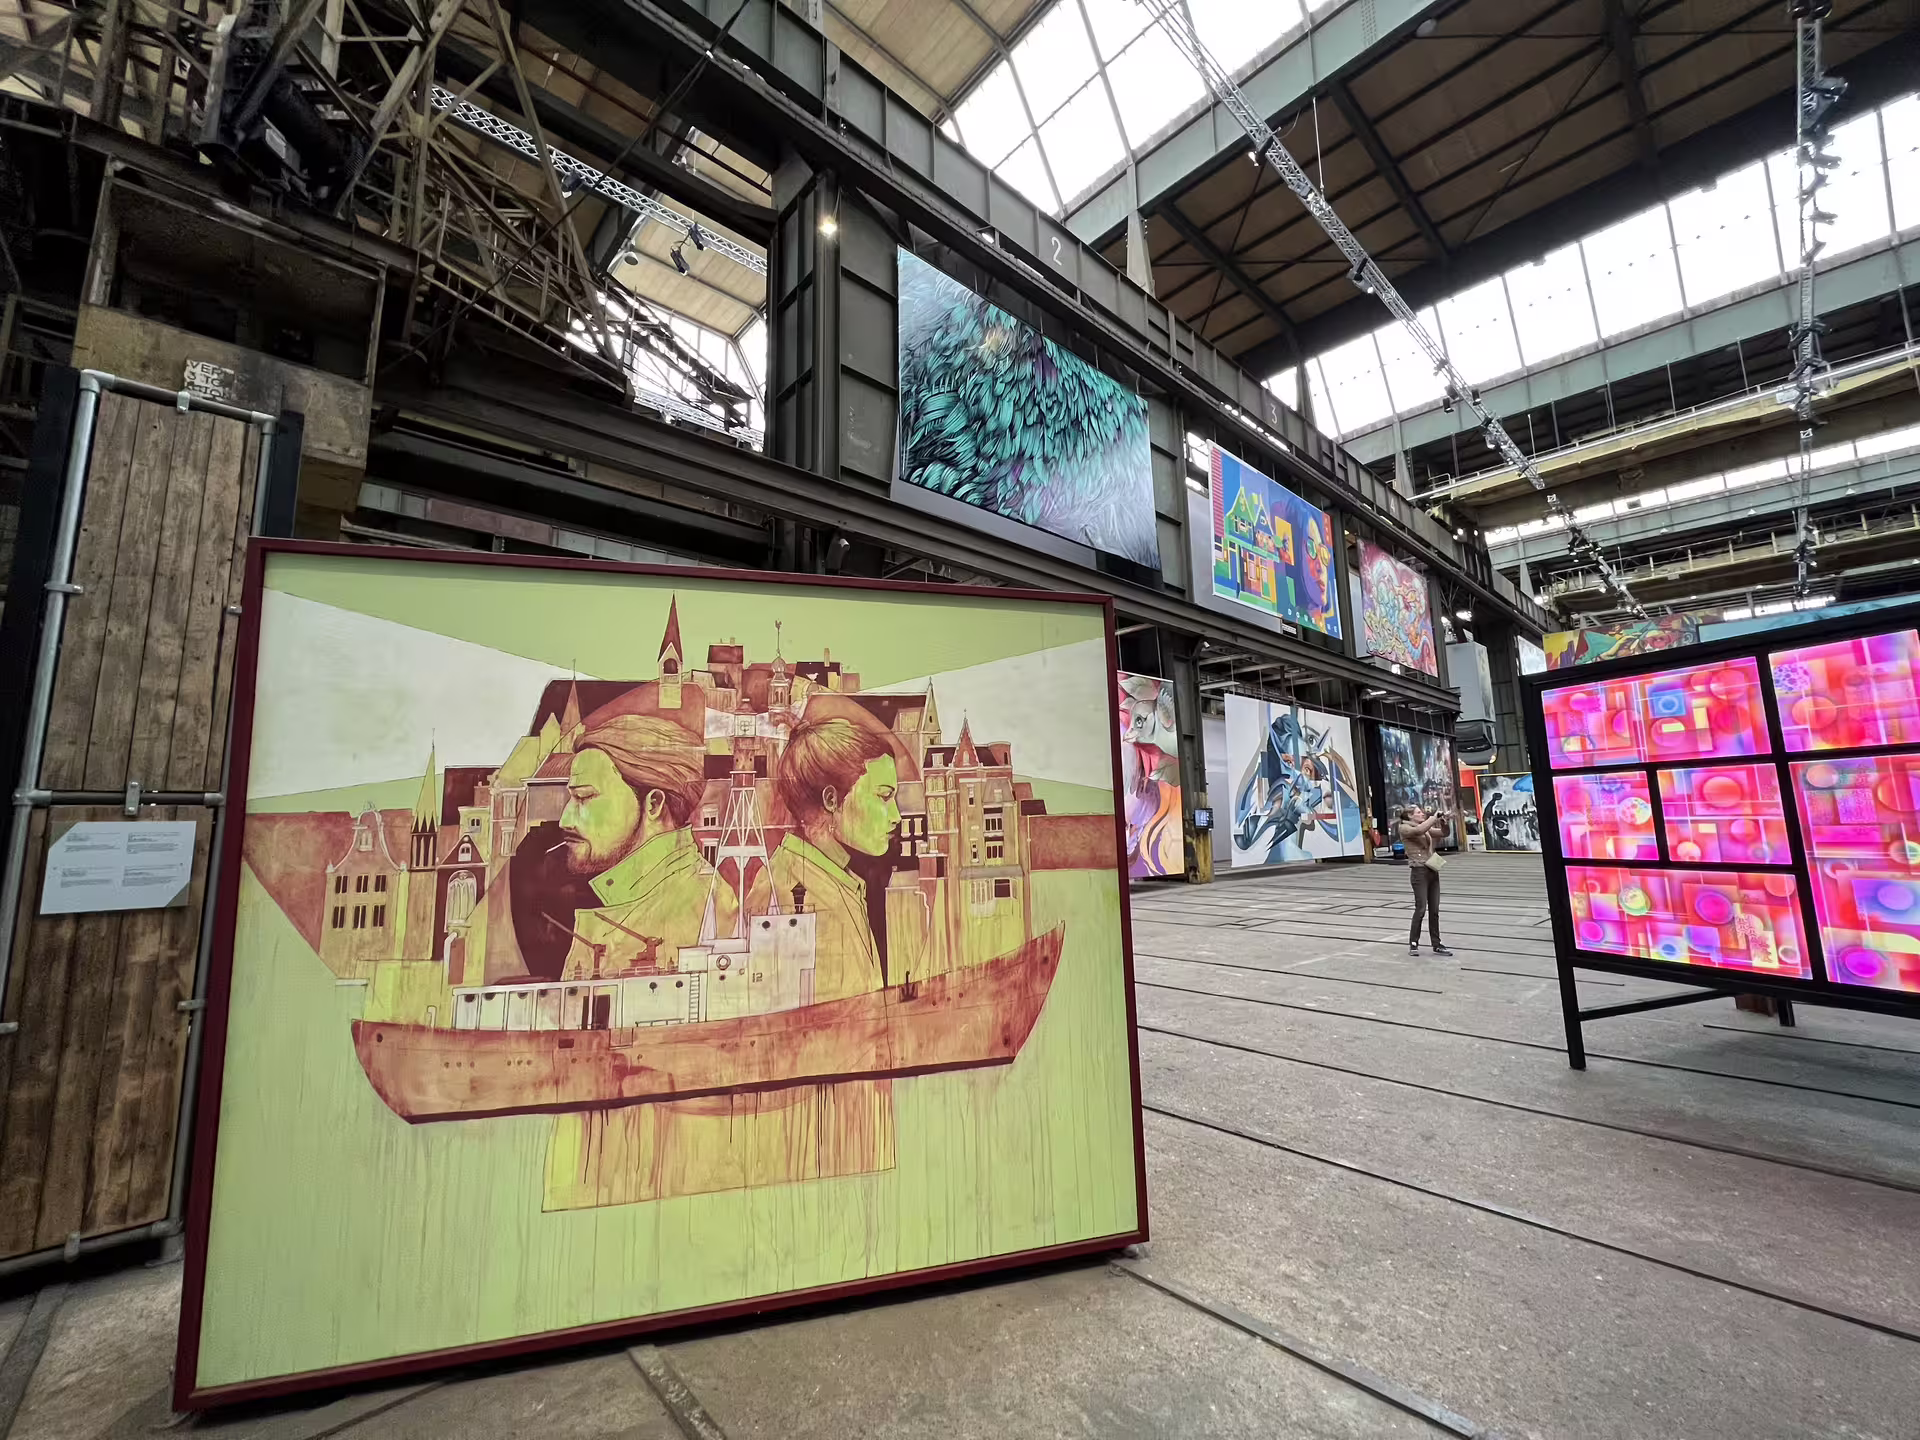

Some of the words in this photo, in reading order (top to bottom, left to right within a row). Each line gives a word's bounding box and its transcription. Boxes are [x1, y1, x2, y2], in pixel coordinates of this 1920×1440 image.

[1051, 236, 1062, 266] 2
[1270, 402, 1278, 424] 3
[1390, 498, 1396, 513] 4
[752, 972, 763, 983] 12
